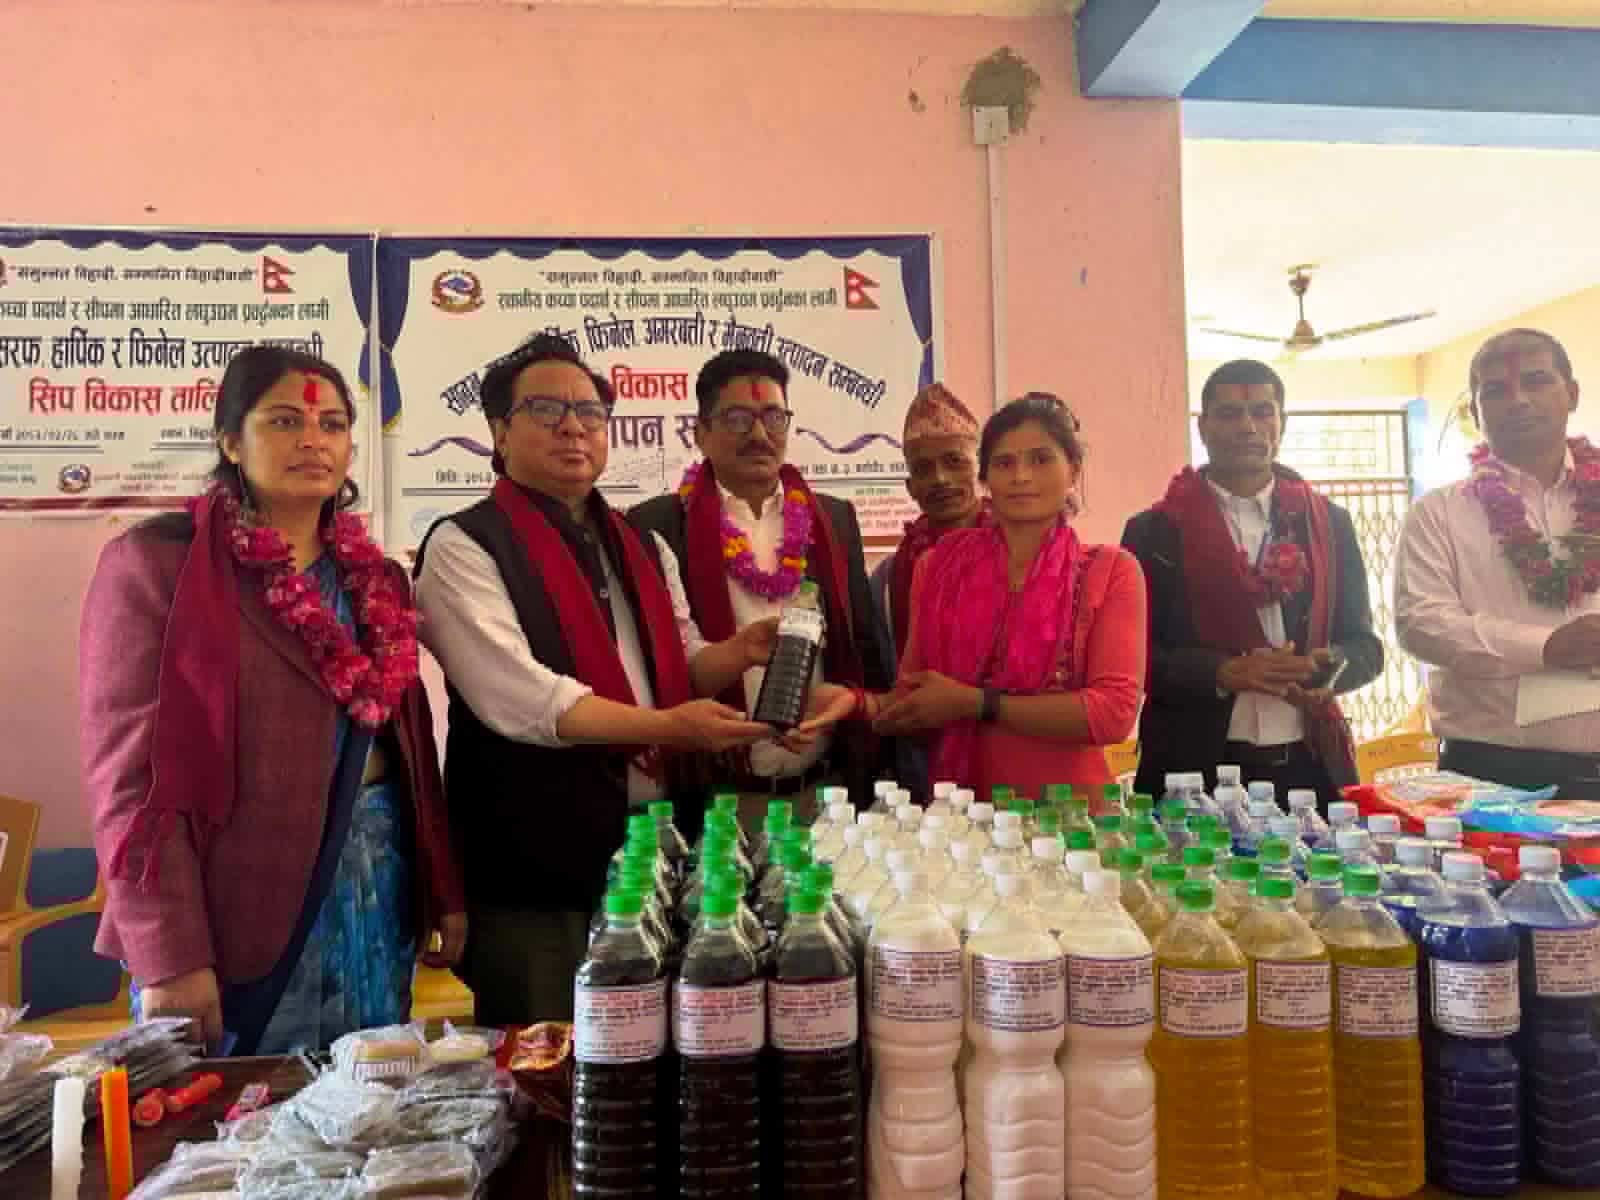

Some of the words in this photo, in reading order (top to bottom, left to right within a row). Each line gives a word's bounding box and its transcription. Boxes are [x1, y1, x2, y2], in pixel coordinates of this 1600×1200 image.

[112, 337, 123, 369] र
[30, 377, 74, 414] सिप
[85, 377, 162, 415] विकास
[611, 365, 689, 401] विकास
